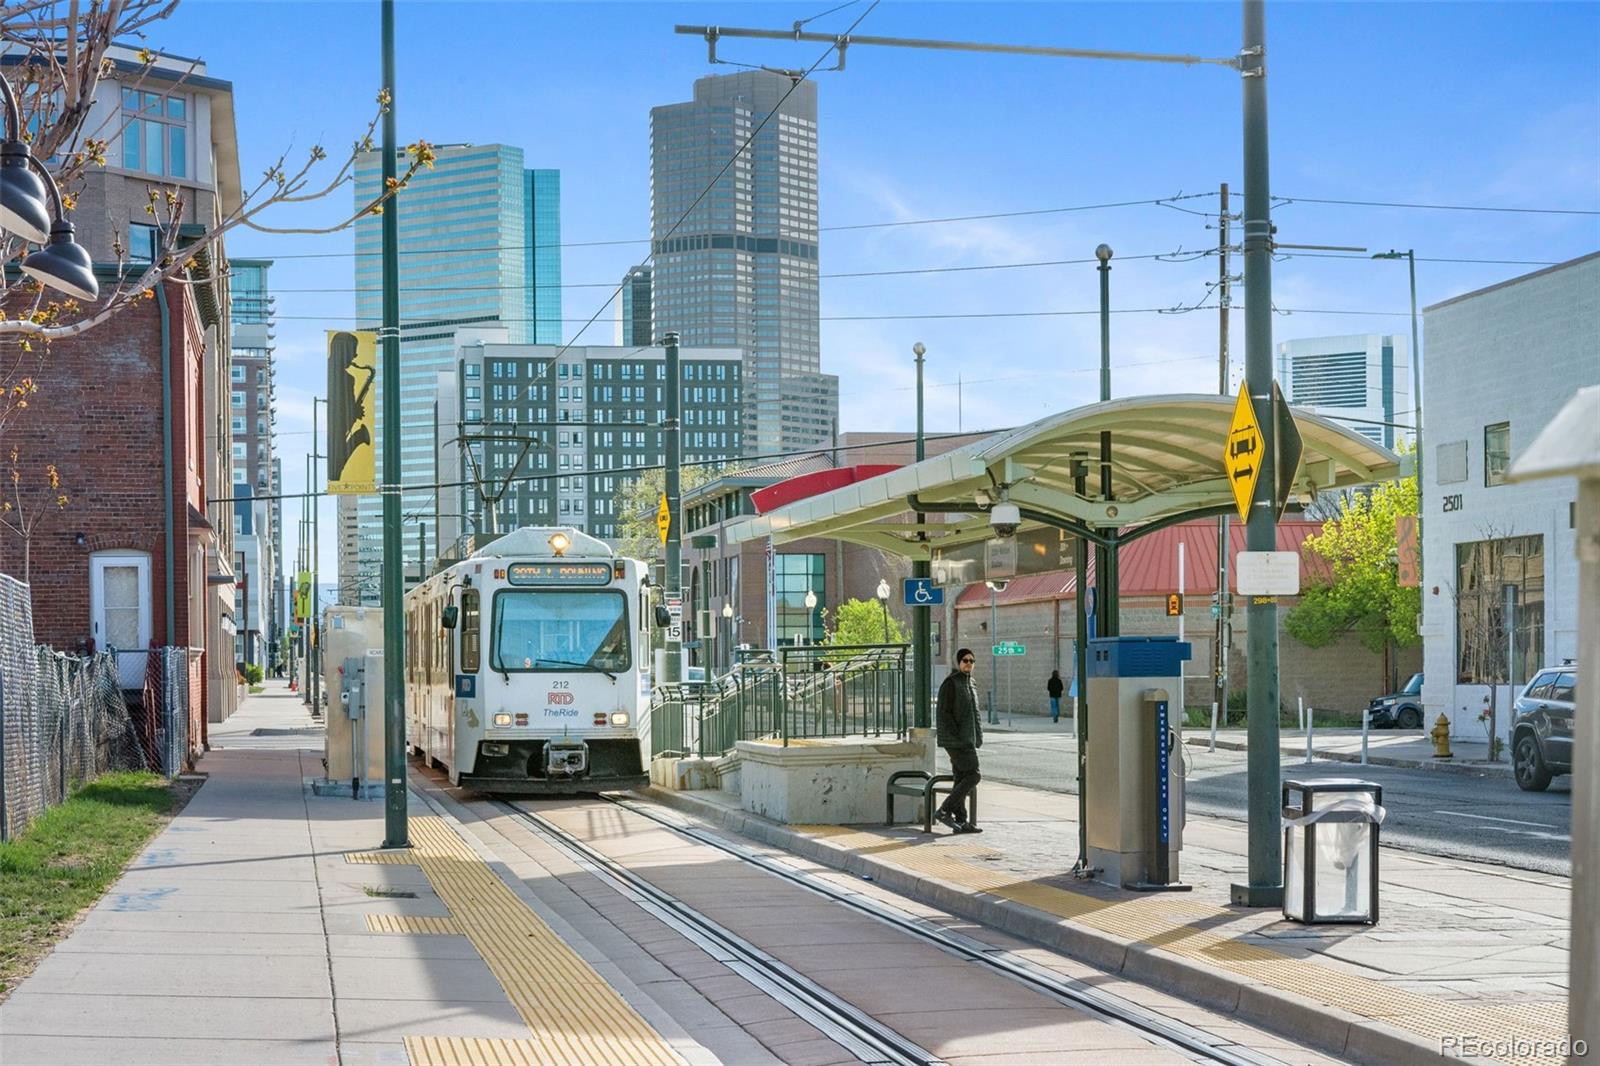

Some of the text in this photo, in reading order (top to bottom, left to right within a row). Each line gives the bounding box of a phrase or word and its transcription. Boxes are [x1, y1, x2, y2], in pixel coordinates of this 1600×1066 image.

[1443, 493, 1463, 512] 2501
[667, 627, 681, 637] 15
[552, 681, 570, 689] 212
